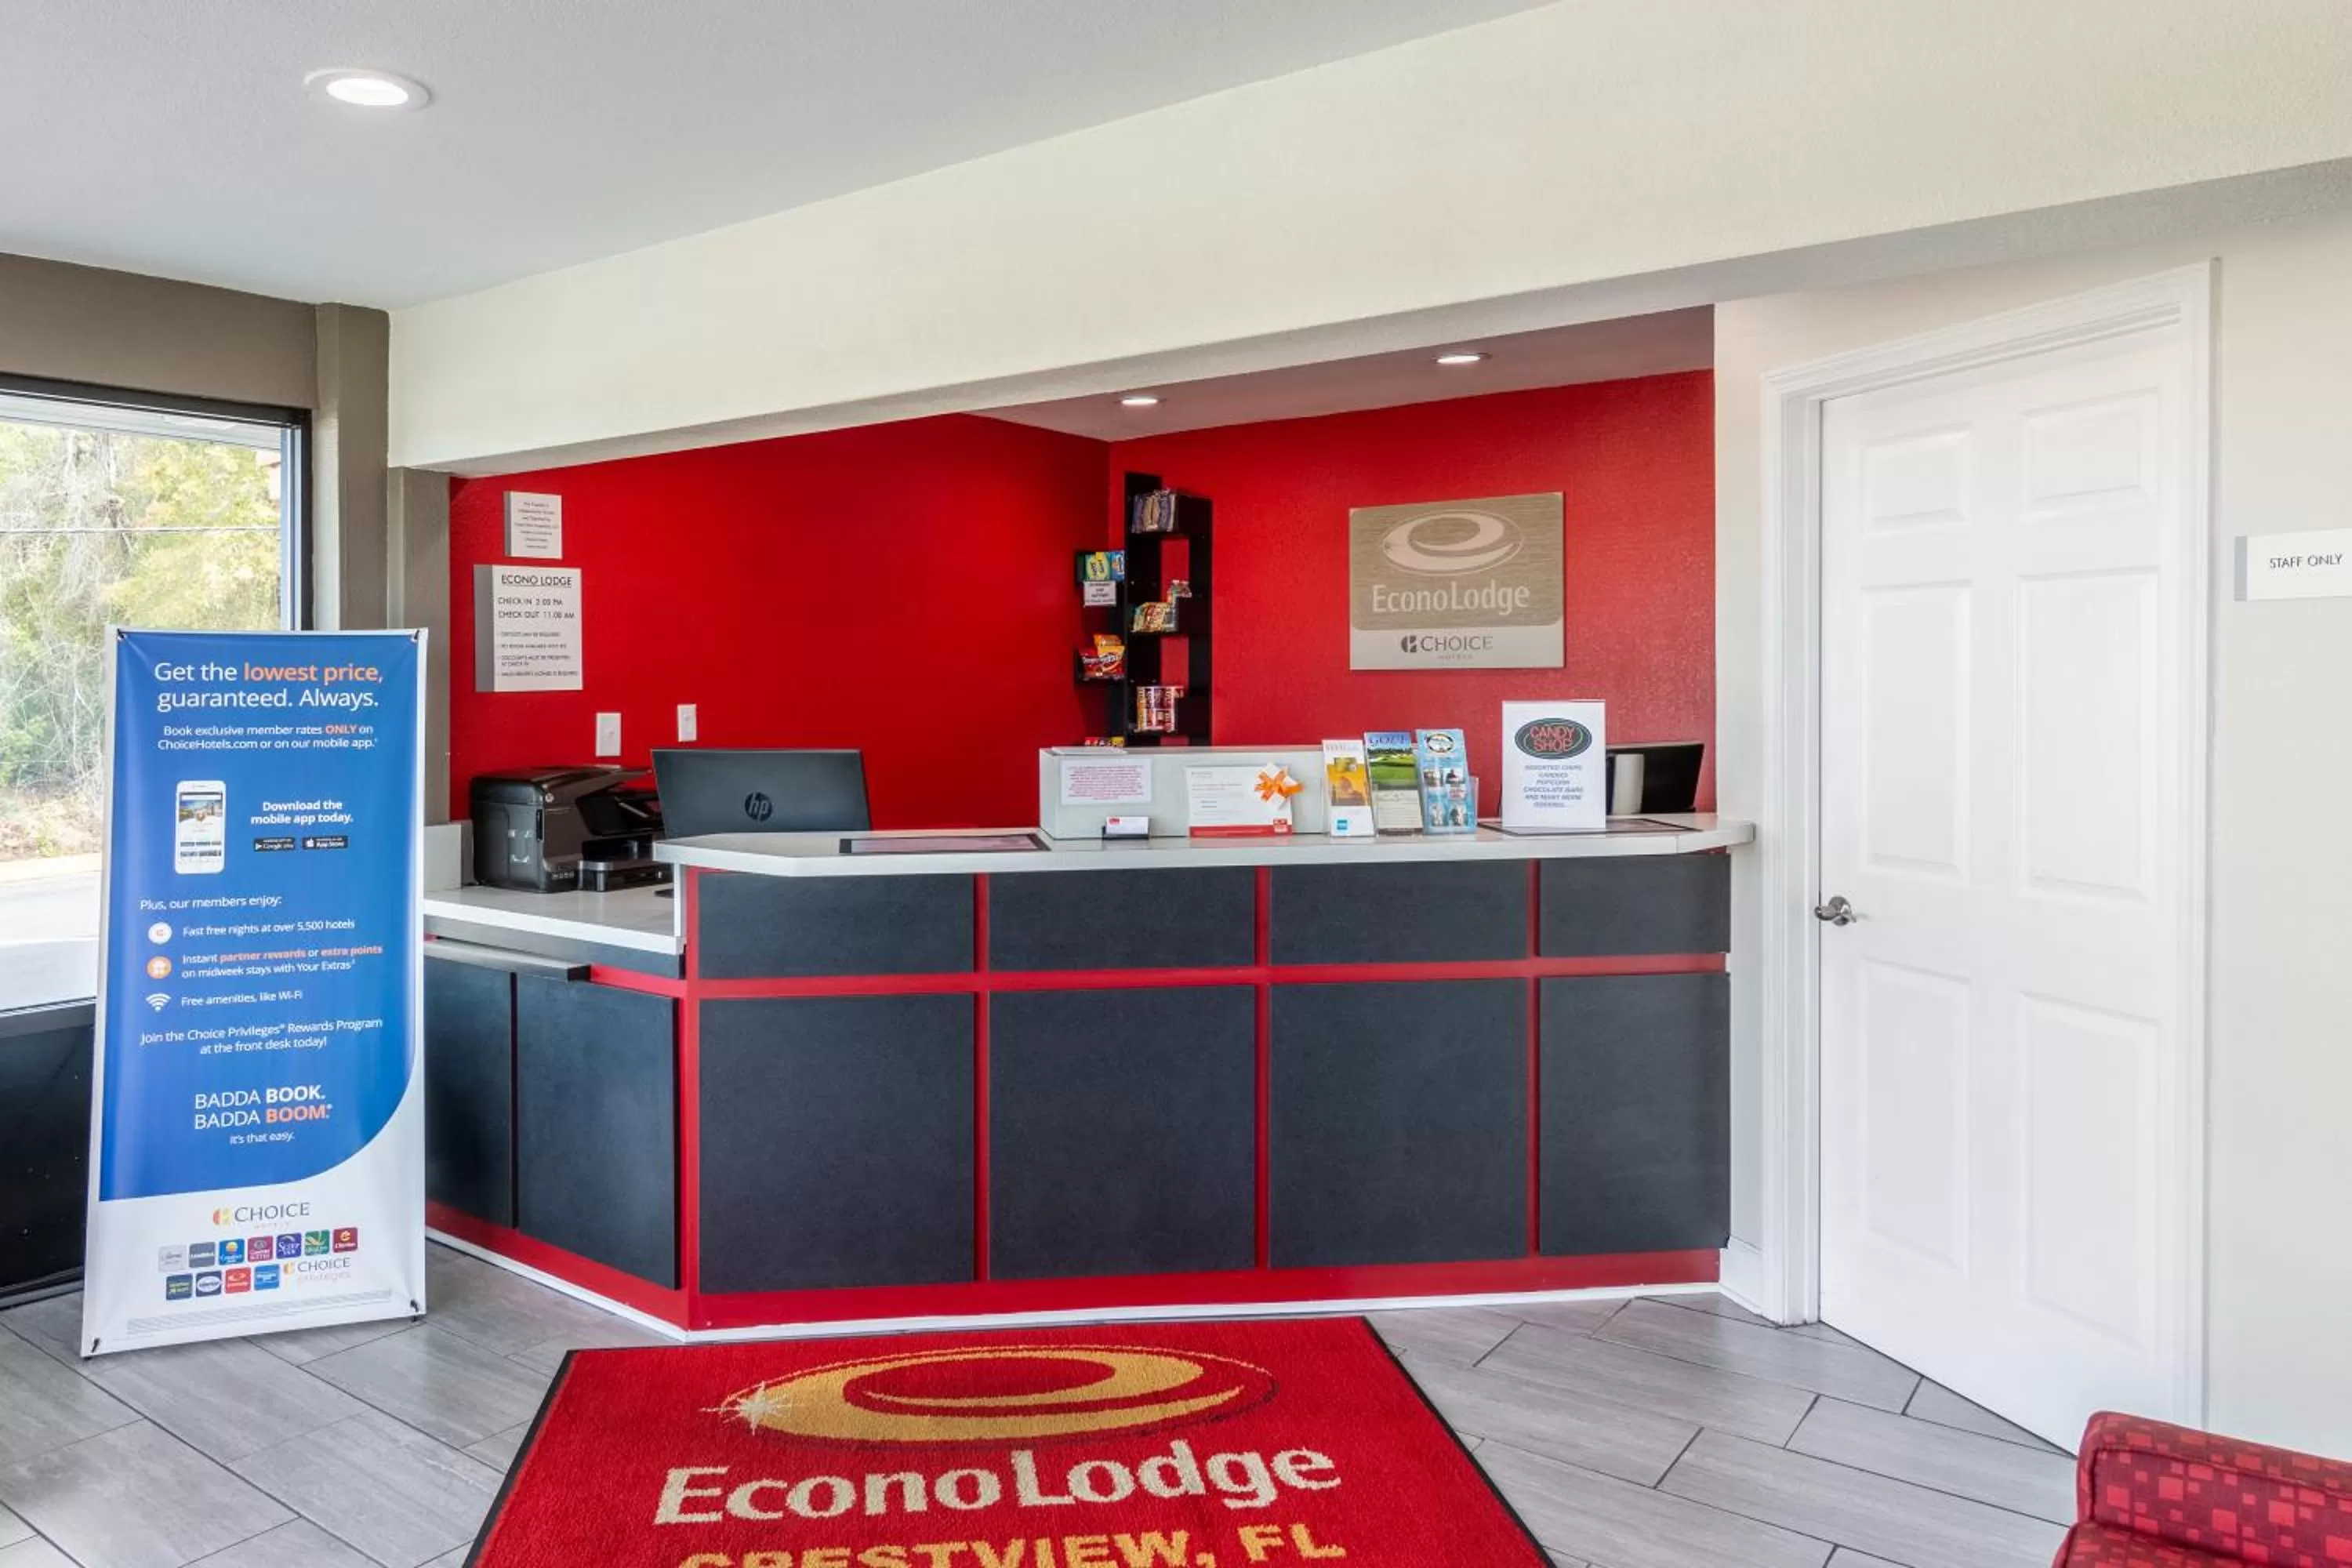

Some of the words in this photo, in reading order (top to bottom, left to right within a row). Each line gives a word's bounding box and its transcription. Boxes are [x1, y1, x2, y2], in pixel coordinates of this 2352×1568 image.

[2270, 556, 2303, 568] STAFF
[2307, 553, 2343, 567] ONLY
[501, 574, 539, 585] ECONO
[540, 575, 572, 586] LODGE
[498, 597, 522, 605] CHECK
[1372, 579, 1530, 615] EconoLodge
[1421, 635, 1494, 652] CHOICE
[154, 662, 194, 681] Get
[201, 662, 238, 681] the
[244, 662, 318, 681] lowest
[324, 662, 383, 686] price,
[158, 688, 293, 713] guaranteed.
[299, 688, 379, 711] Always.
[163, 724, 193, 736] Book
[195, 724, 245, 736] exclusive
[247, 724, 294, 735] member
[296, 724, 322, 735] rates
[325, 724, 358, 735] ONLY
[359, 725, 374, 735] on
[1530, 726, 1575, 741] CANDY
[158, 739, 258, 750] ChoiceHotels.com
[260, 740, 272, 749] or
[274, 740, 289, 749] on
[291, 739, 310, 749] our
[313, 737, 350, 748] mobile
[263, 800, 321, 811] Download
[323, 800, 343, 810] the
[251, 814, 292, 825] mobile
[293, 815, 316, 826] app
[318, 811, 354, 825] today.
[140, 898, 167, 910] Plus,
[169, 900, 189, 909] our
[192, 896, 247, 908] members
[249, 895, 283, 908] enjoy:
[183, 926, 204, 937] Fast
[206, 925, 227, 936] free
[228, 924, 260, 937] nights
[261, 924, 271, 933] at
[273, 923, 295, 932] over
[325, 918, 355, 930] hotels
[183, 953, 219, 964] Instant
[220, 952, 261, 964] partner
[263, 949, 307, 960] rewards
[308, 949, 320, 957] or
[321, 946, 348, 957] extra
[350, 945, 383, 957] points
[181, 970, 196, 979] on
[198, 966, 245, 978] midweek
[245, 964, 272, 977] stays
[273, 963, 296, 974] with
[297, 961, 320, 972] Your
[181, 996, 204, 1007] Free
[205, 993, 257, 1005] amenities,
[260, 991, 277, 1002] like
[278, 989, 303, 1000] Wi-Fi
[139, 1031, 164, 1047] Join
[165, 1030, 186, 1042] the
[187, 1028, 226, 1041] Choice
[287, 1021, 335, 1034] Rewards
[336, 1018, 383, 1033] Program
[200, 1044, 212, 1055] at
[214, 1042, 233, 1054] the
[235, 1040, 264, 1052] front
[265, 1037, 292, 1051] desk
[293, 1035, 327, 1051] today!
[194, 1089, 262, 1110] BADDA
[265, 1084, 326, 1104] BOOK.
[194, 1109, 261, 1131] BADDA
[246, 1132, 268, 1144] that
[269, 1131, 296, 1143] easy.
[234, 1201, 311, 1223] CHOICE
[297, 1257, 352, 1272] CHOICE
[654, 1439, 1342, 1525] EconoLodge
[1238, 1523, 1347, 1562] FL
